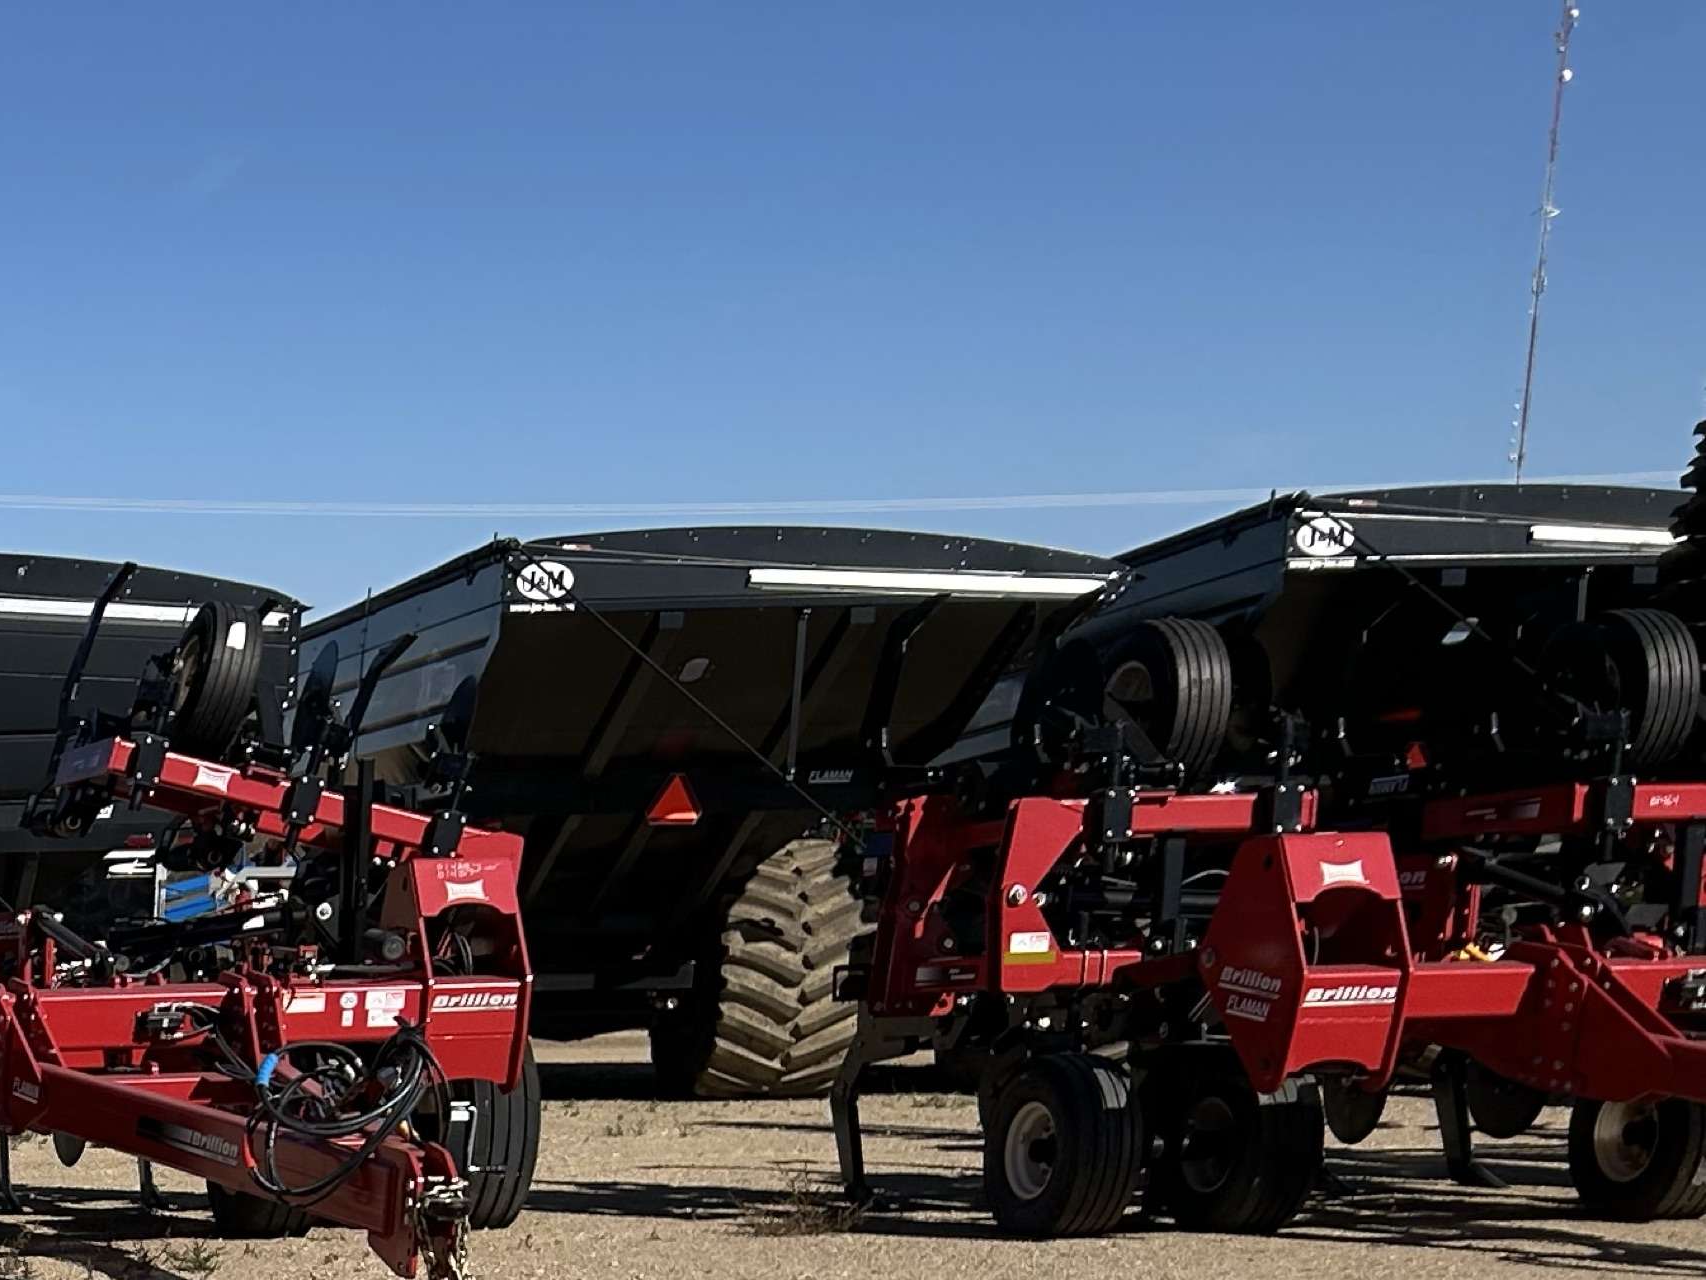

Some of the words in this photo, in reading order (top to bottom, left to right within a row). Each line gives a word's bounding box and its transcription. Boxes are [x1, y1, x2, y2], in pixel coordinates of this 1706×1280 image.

[1221, 966, 1282, 993] Brillion
[433, 993, 518, 1009] Brillion
[1304, 986, 1397, 1003] Brillion
[1226, 995, 1270, 1017] FLAMAN
[191, 1129, 239, 1158] Brillion
